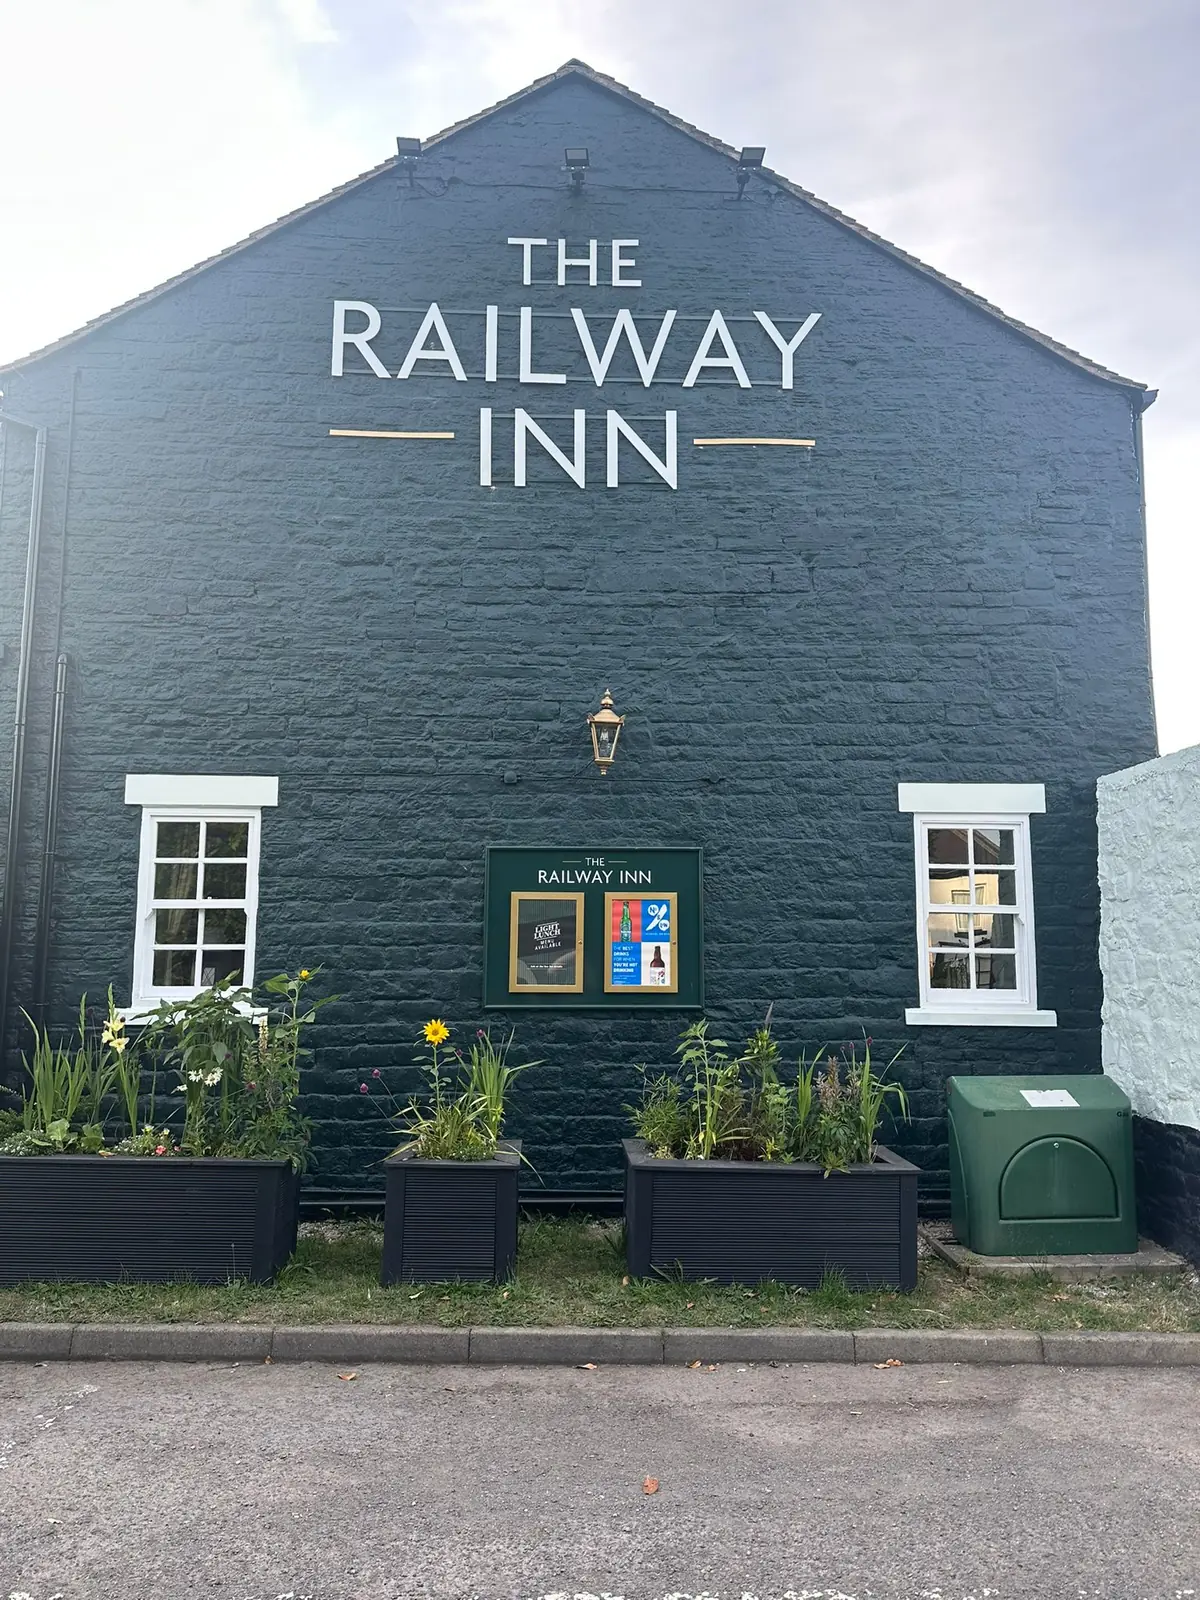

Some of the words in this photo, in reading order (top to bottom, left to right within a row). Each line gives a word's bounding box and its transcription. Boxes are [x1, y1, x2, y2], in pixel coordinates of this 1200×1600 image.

[507, 237, 642, 287] THE
[330, 300, 823, 390] RAILWAY
[480, 407, 678, 490] INN
[585, 857, 605, 867] THE
[538, 870, 613, 884] RAILWAY
[620, 870, 652, 884] INN
[535, 923, 560, 933] LIGHT
[533, 929, 561, 940] LUNCH
[534, 941, 561, 951] AVAILABLE
